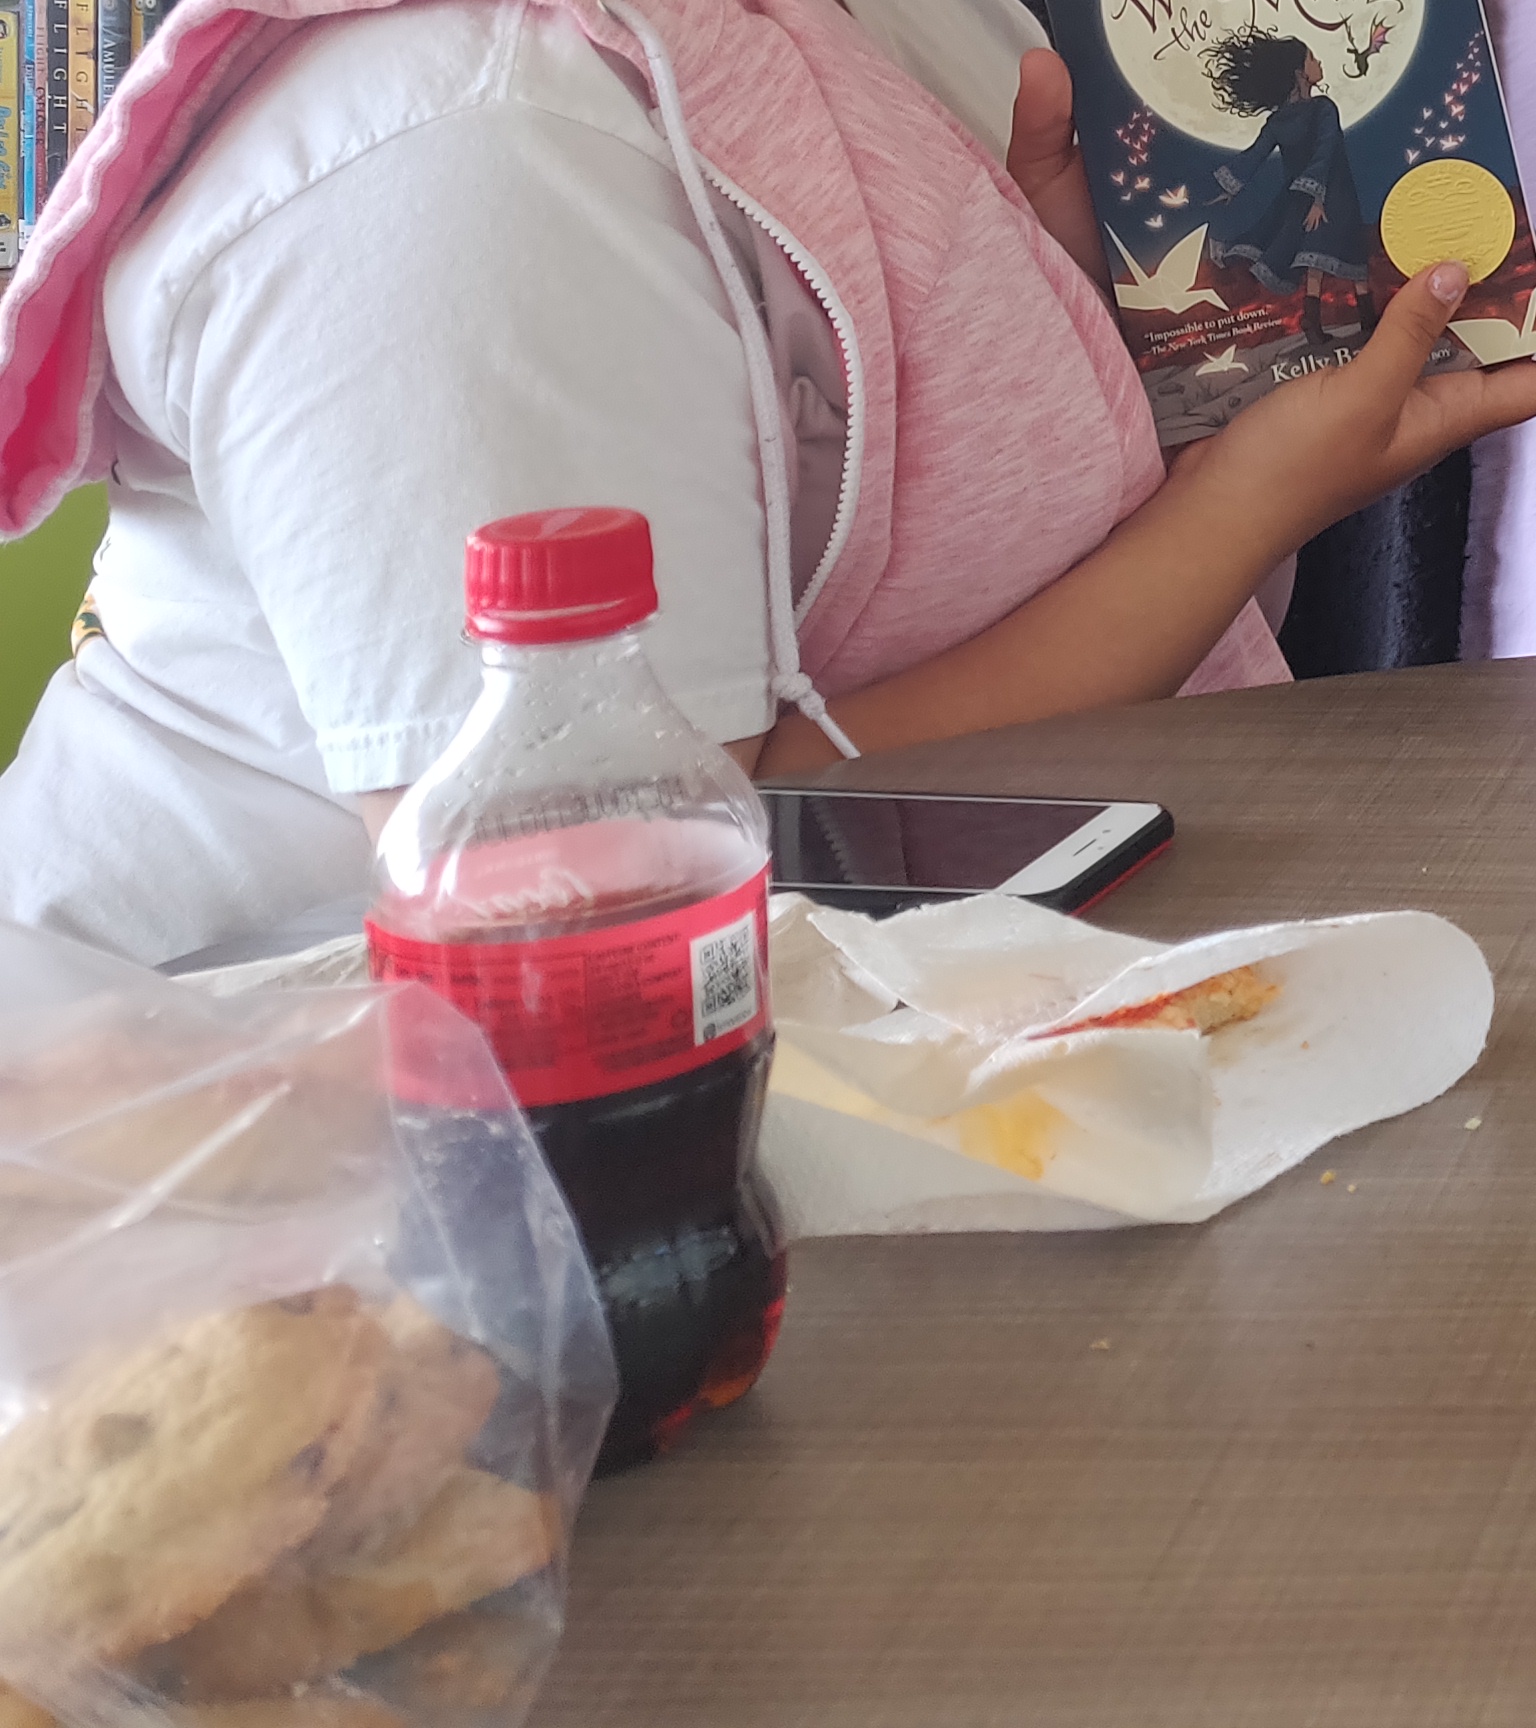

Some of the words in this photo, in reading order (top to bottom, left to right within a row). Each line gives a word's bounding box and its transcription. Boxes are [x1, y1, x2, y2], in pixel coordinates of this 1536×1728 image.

[1153, 6, 1213, 60] the
[54, 0, 67, 135] FLIGHT
[75, 3, 89, 134] FLIGHT
[35, 87, 46, 146] EXPLORER
[1168, 341, 1186, 352] New
[1188, 336, 1208, 347] York
[1207, 332, 1231, 343] Times
[1232, 324, 1252, 337] Book
[1253, 318, 1282, 331] Review
[1204, 320, 1216, 330] to
[1217, 315, 1236, 329] put
[1271, 353, 1330, 384] Kelly
[1431, 348, 1451, 361] BOY
